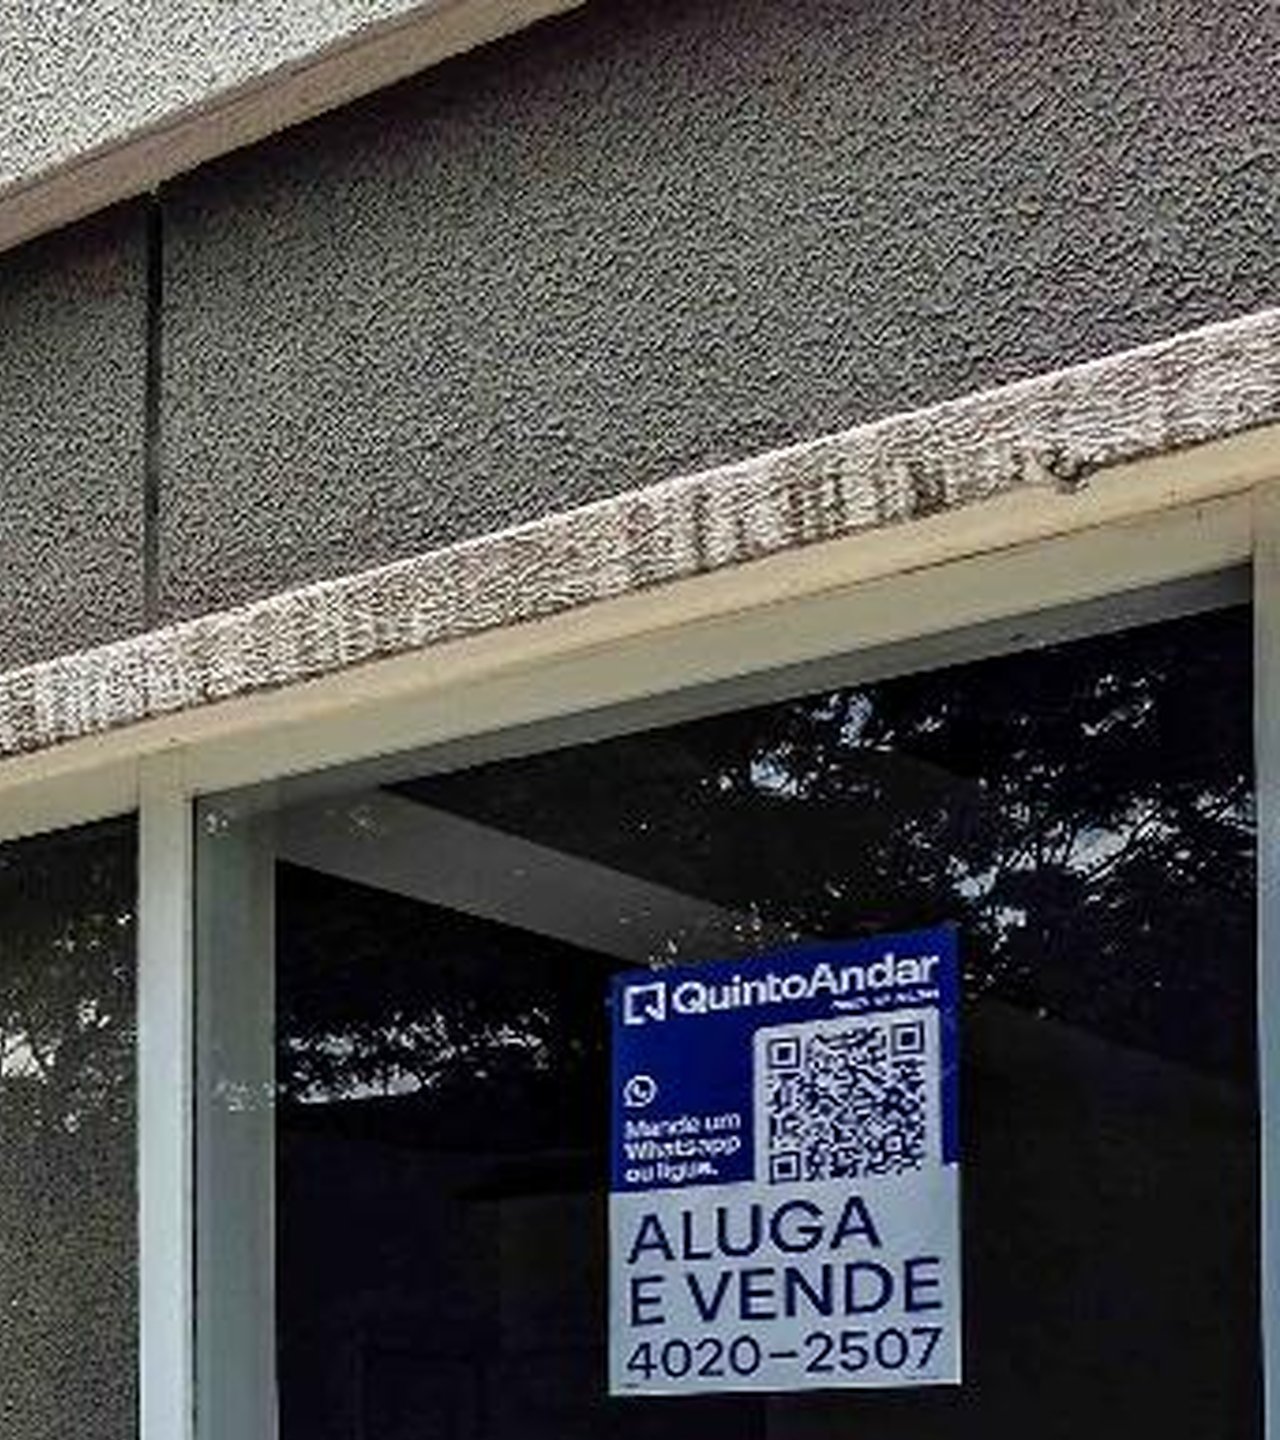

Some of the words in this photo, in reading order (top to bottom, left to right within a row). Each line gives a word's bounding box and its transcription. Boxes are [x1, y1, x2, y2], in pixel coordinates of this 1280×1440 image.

[671, 953, 940, 1014] QuintoAndar
[704, 1113, 741, 1131] um
[625, 1165, 654, 1183] ou
[627, 1197, 882, 1264] ALUGA
[630, 1276, 665, 1326] E
[687, 1257, 944, 1322] VENDE
[626, 1327, 943, 1380] 4020-2507
